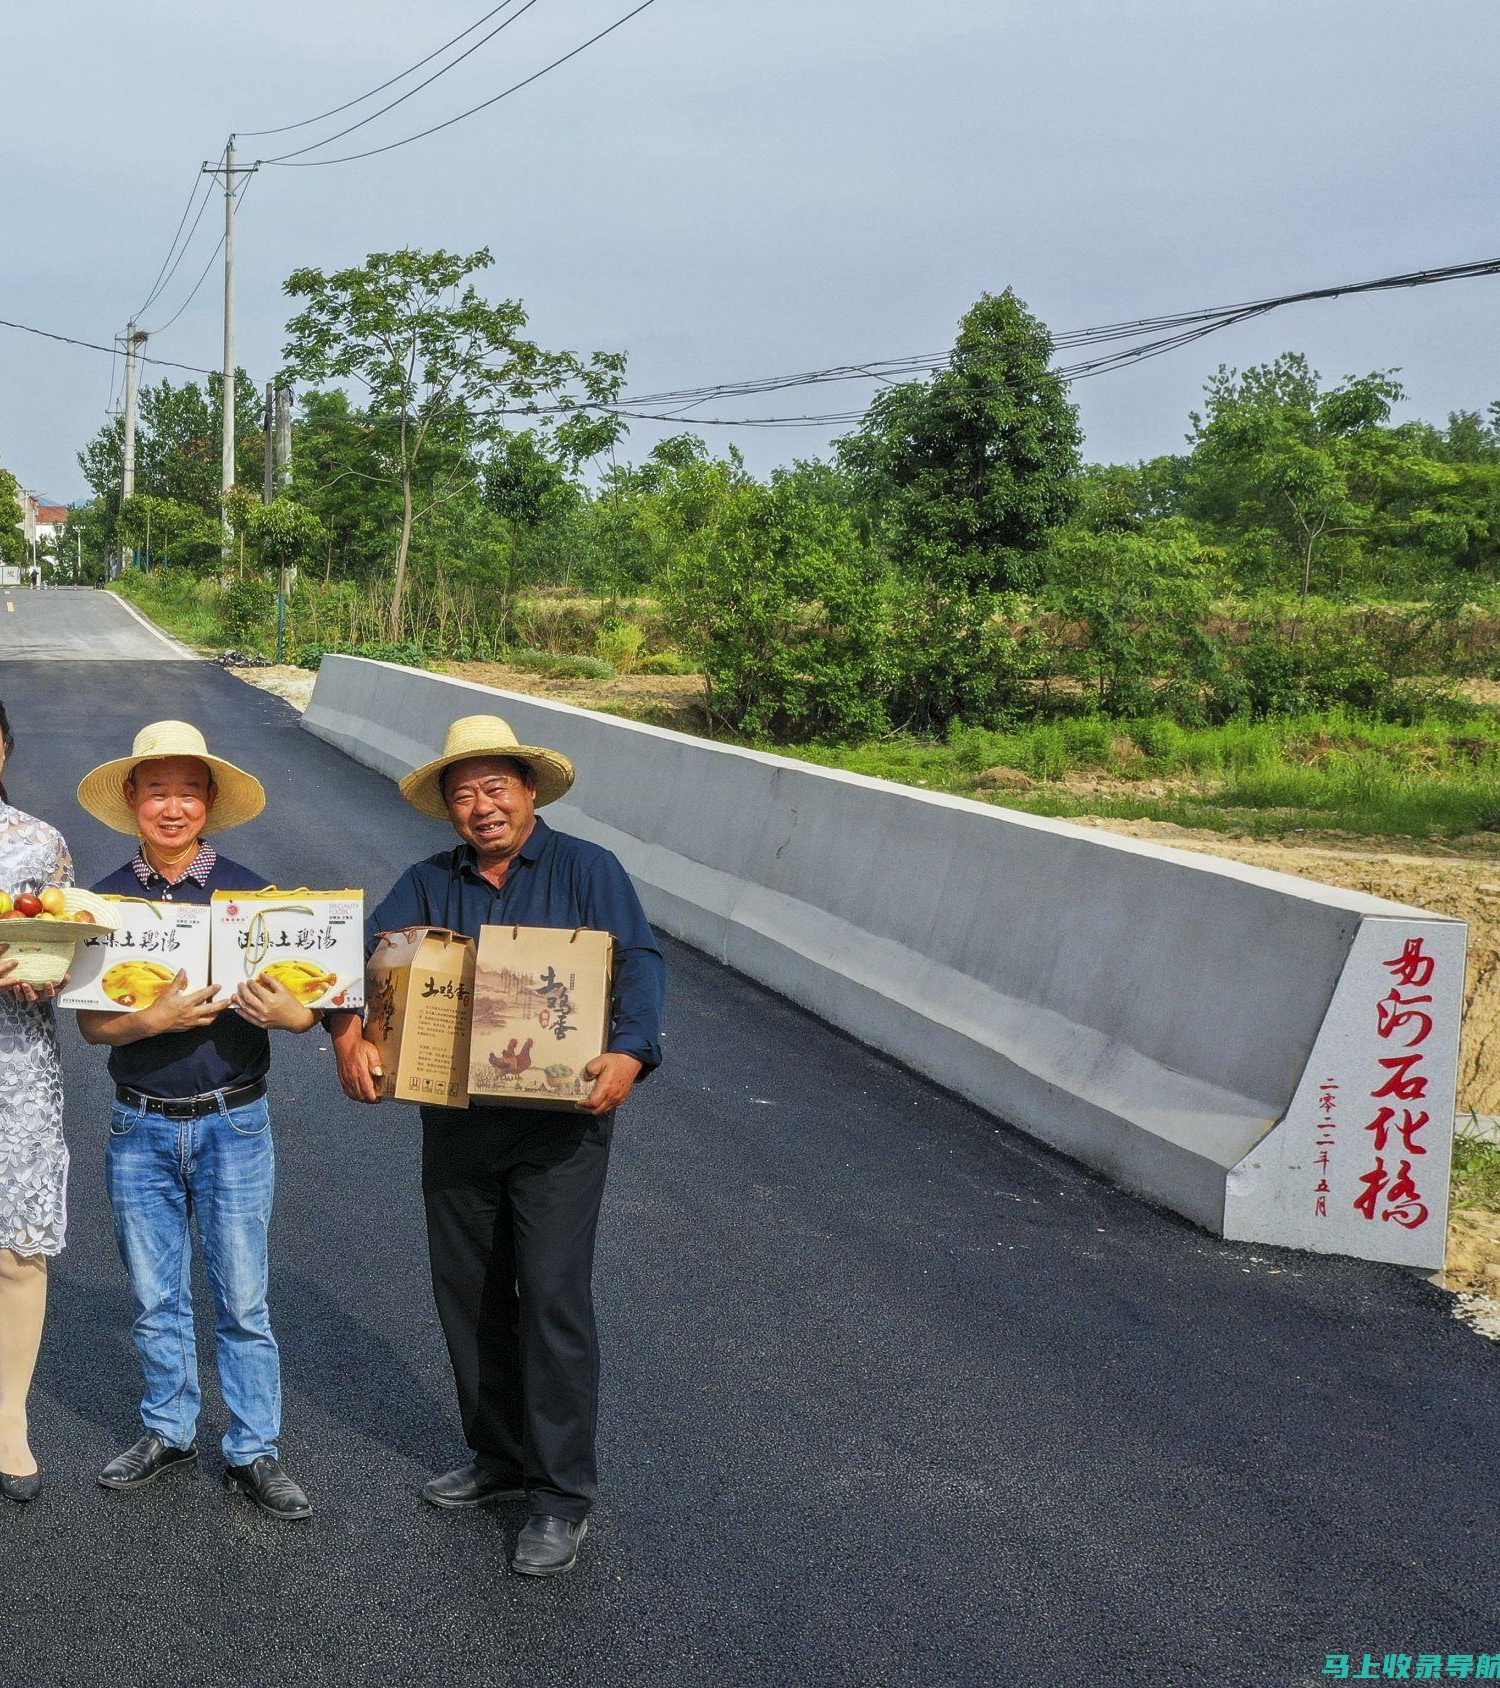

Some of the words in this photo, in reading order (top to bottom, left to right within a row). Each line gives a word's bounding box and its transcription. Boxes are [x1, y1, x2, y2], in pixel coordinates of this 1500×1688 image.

[421, 976, 470, 1001] 土鸡蛋
[536, 966, 578, 1041] 土鸡蛋
[1313, 1078, 1340, 1217] 二零二二年五月
